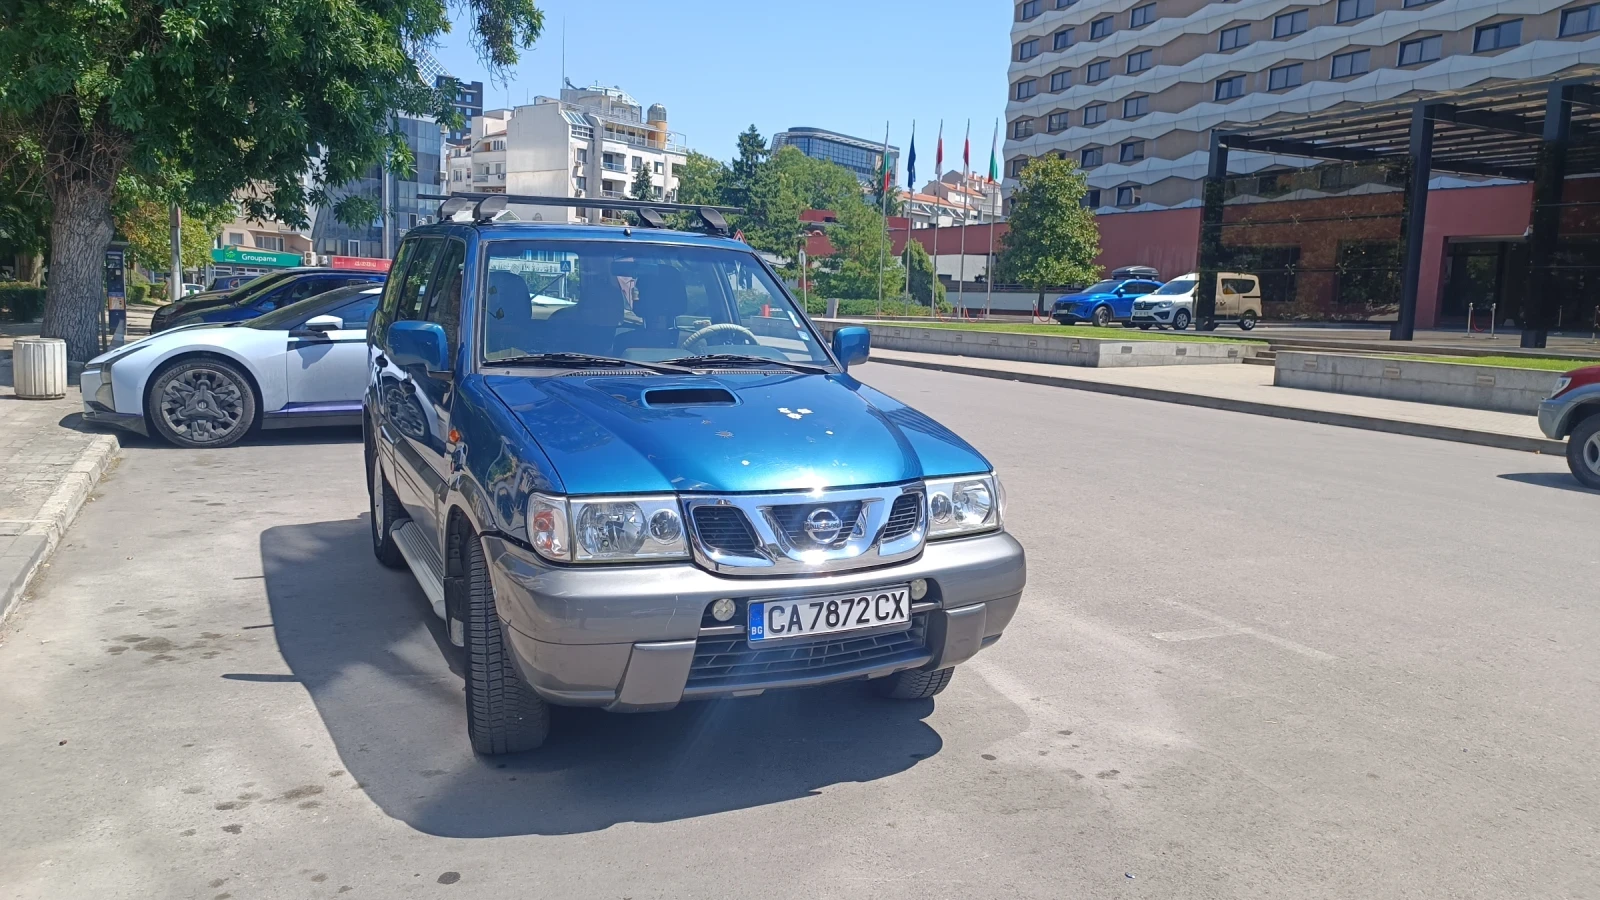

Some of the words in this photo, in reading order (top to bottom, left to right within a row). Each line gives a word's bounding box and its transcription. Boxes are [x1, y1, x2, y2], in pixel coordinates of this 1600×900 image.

[241, 253, 277, 263] Groupama
[768, 604, 803, 634] CA
[809, 596, 870, 630] 7872
[875, 591, 905, 622] CX
[751, 626, 763, 636] BG
